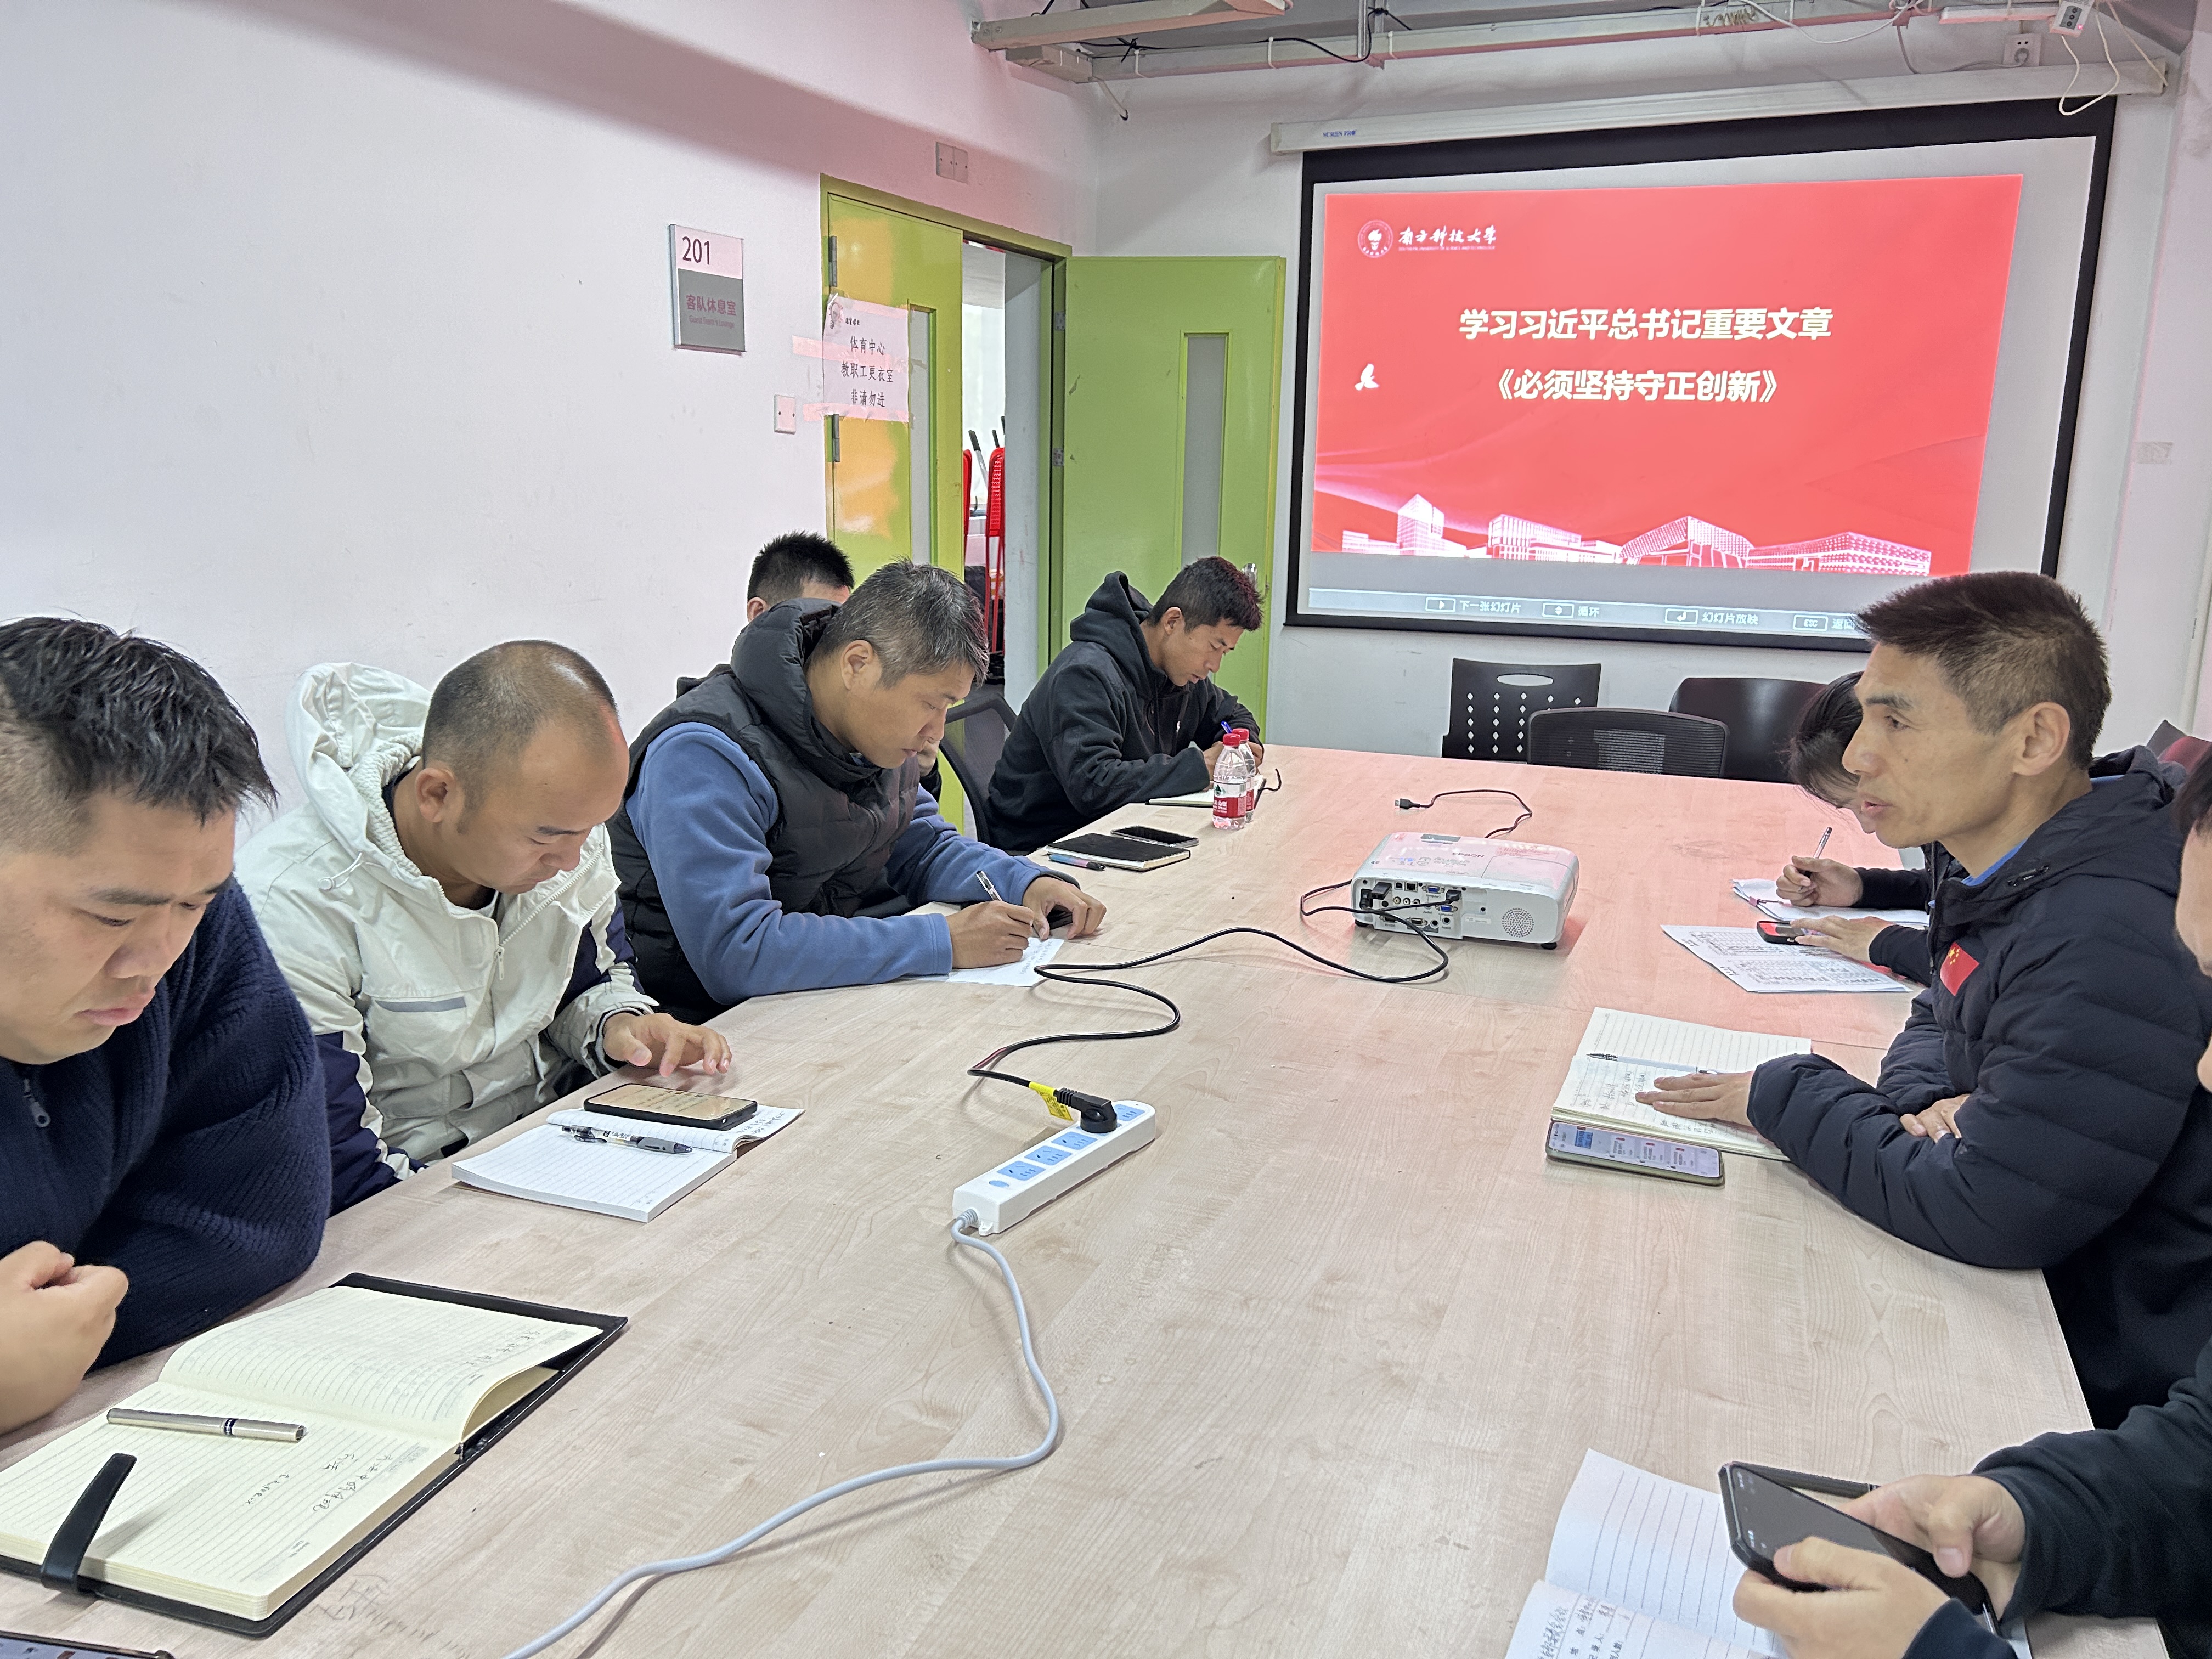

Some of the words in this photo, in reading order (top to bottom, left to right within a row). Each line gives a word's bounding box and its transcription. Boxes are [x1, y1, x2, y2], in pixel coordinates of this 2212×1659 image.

[1398, 225, 1497, 246] 南方科技大学
[682, 236, 710, 265] 201
[686, 294, 736, 316] 客队休息室
[1459, 307, 1833, 341] 学习习近平总书记重要文章
[850, 335, 885, 356] 体育中心
[841, 360, 894, 382] 教职工更衣室
[1498, 368, 1778, 403] 《必须坚持守正创新》
[851, 388, 885, 408] 非请勿进
[1459, 600, 1521, 614] 下一张幻灯片
[1702, 612, 1759, 625] 幻灯片放映
[1804, 619, 1818, 628] ESC
